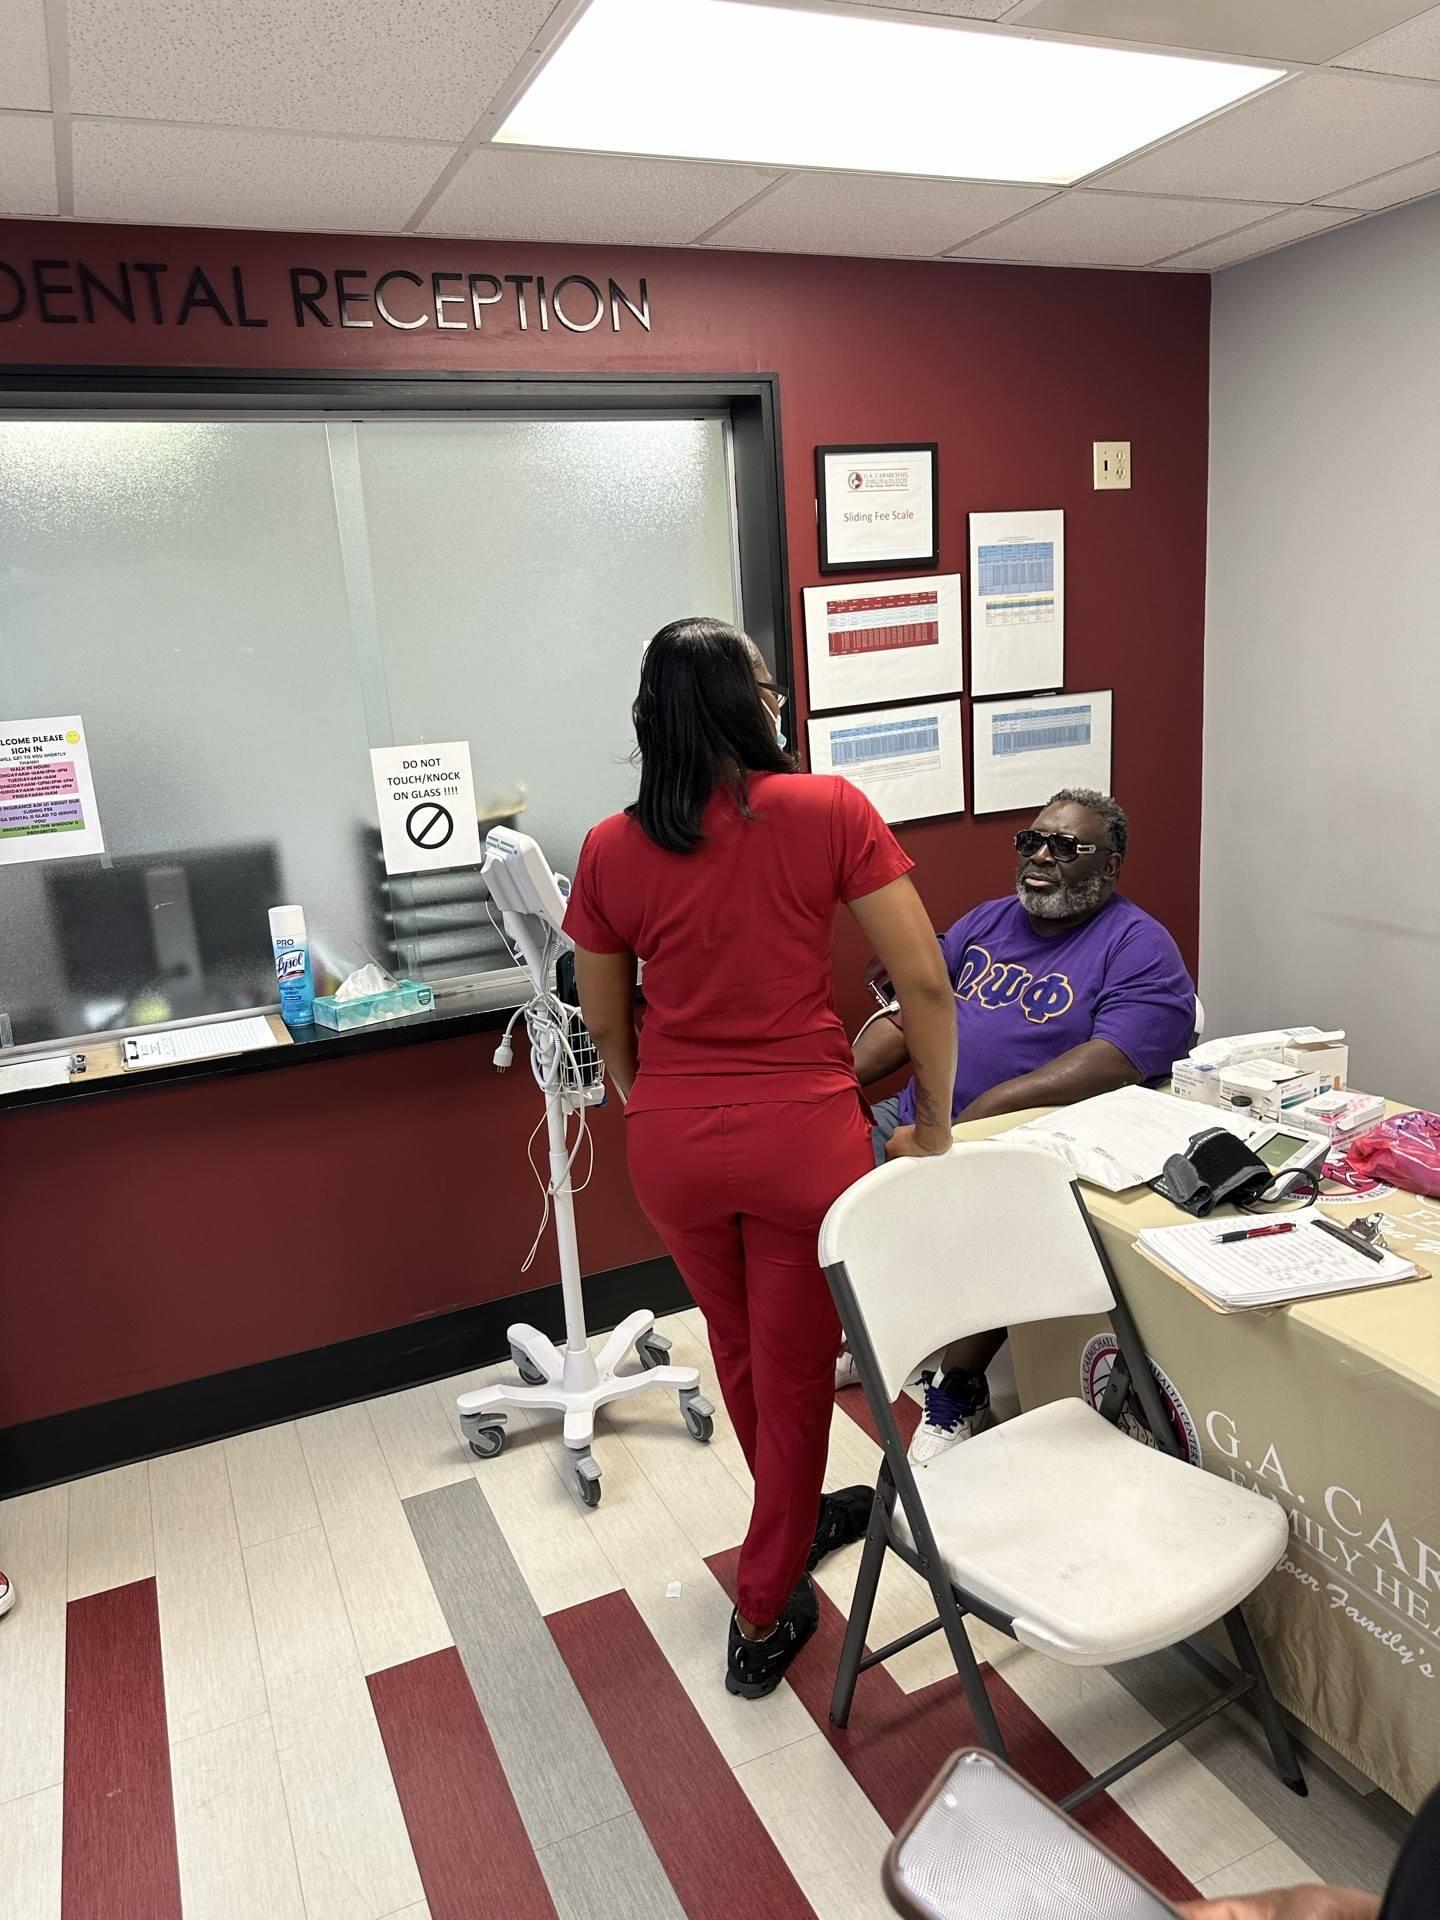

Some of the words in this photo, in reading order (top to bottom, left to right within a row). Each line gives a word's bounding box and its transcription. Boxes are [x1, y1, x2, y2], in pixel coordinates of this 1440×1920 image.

[290, 265, 653, 333] RECEPTION
[844, 512, 873, 524] Sliding
[875, 511, 890, 521] Fee
[892, 509, 914, 520] Scale
[0, 737, 31, 746] LCOME
[32, 734, 64, 744] PLEASE
[11, 747, 31, 755] SIGN
[33, 745, 43, 753] IN
[402, 760, 418, 769] DO
[420, 758, 441, 768] NOT
[387, 771, 461, 786] TOUCH/KNOCK
[393, 792, 409, 801] ON
[411, 788, 441, 799] GLASS
[443, 786, 458, 796] !!!!
[276, 938, 294, 946] PRO
[277, 952, 303, 974] Lysol
[1180, 1411, 1199, 1460] CENTER
[1326, 1582, 1435, 1679] Family's
